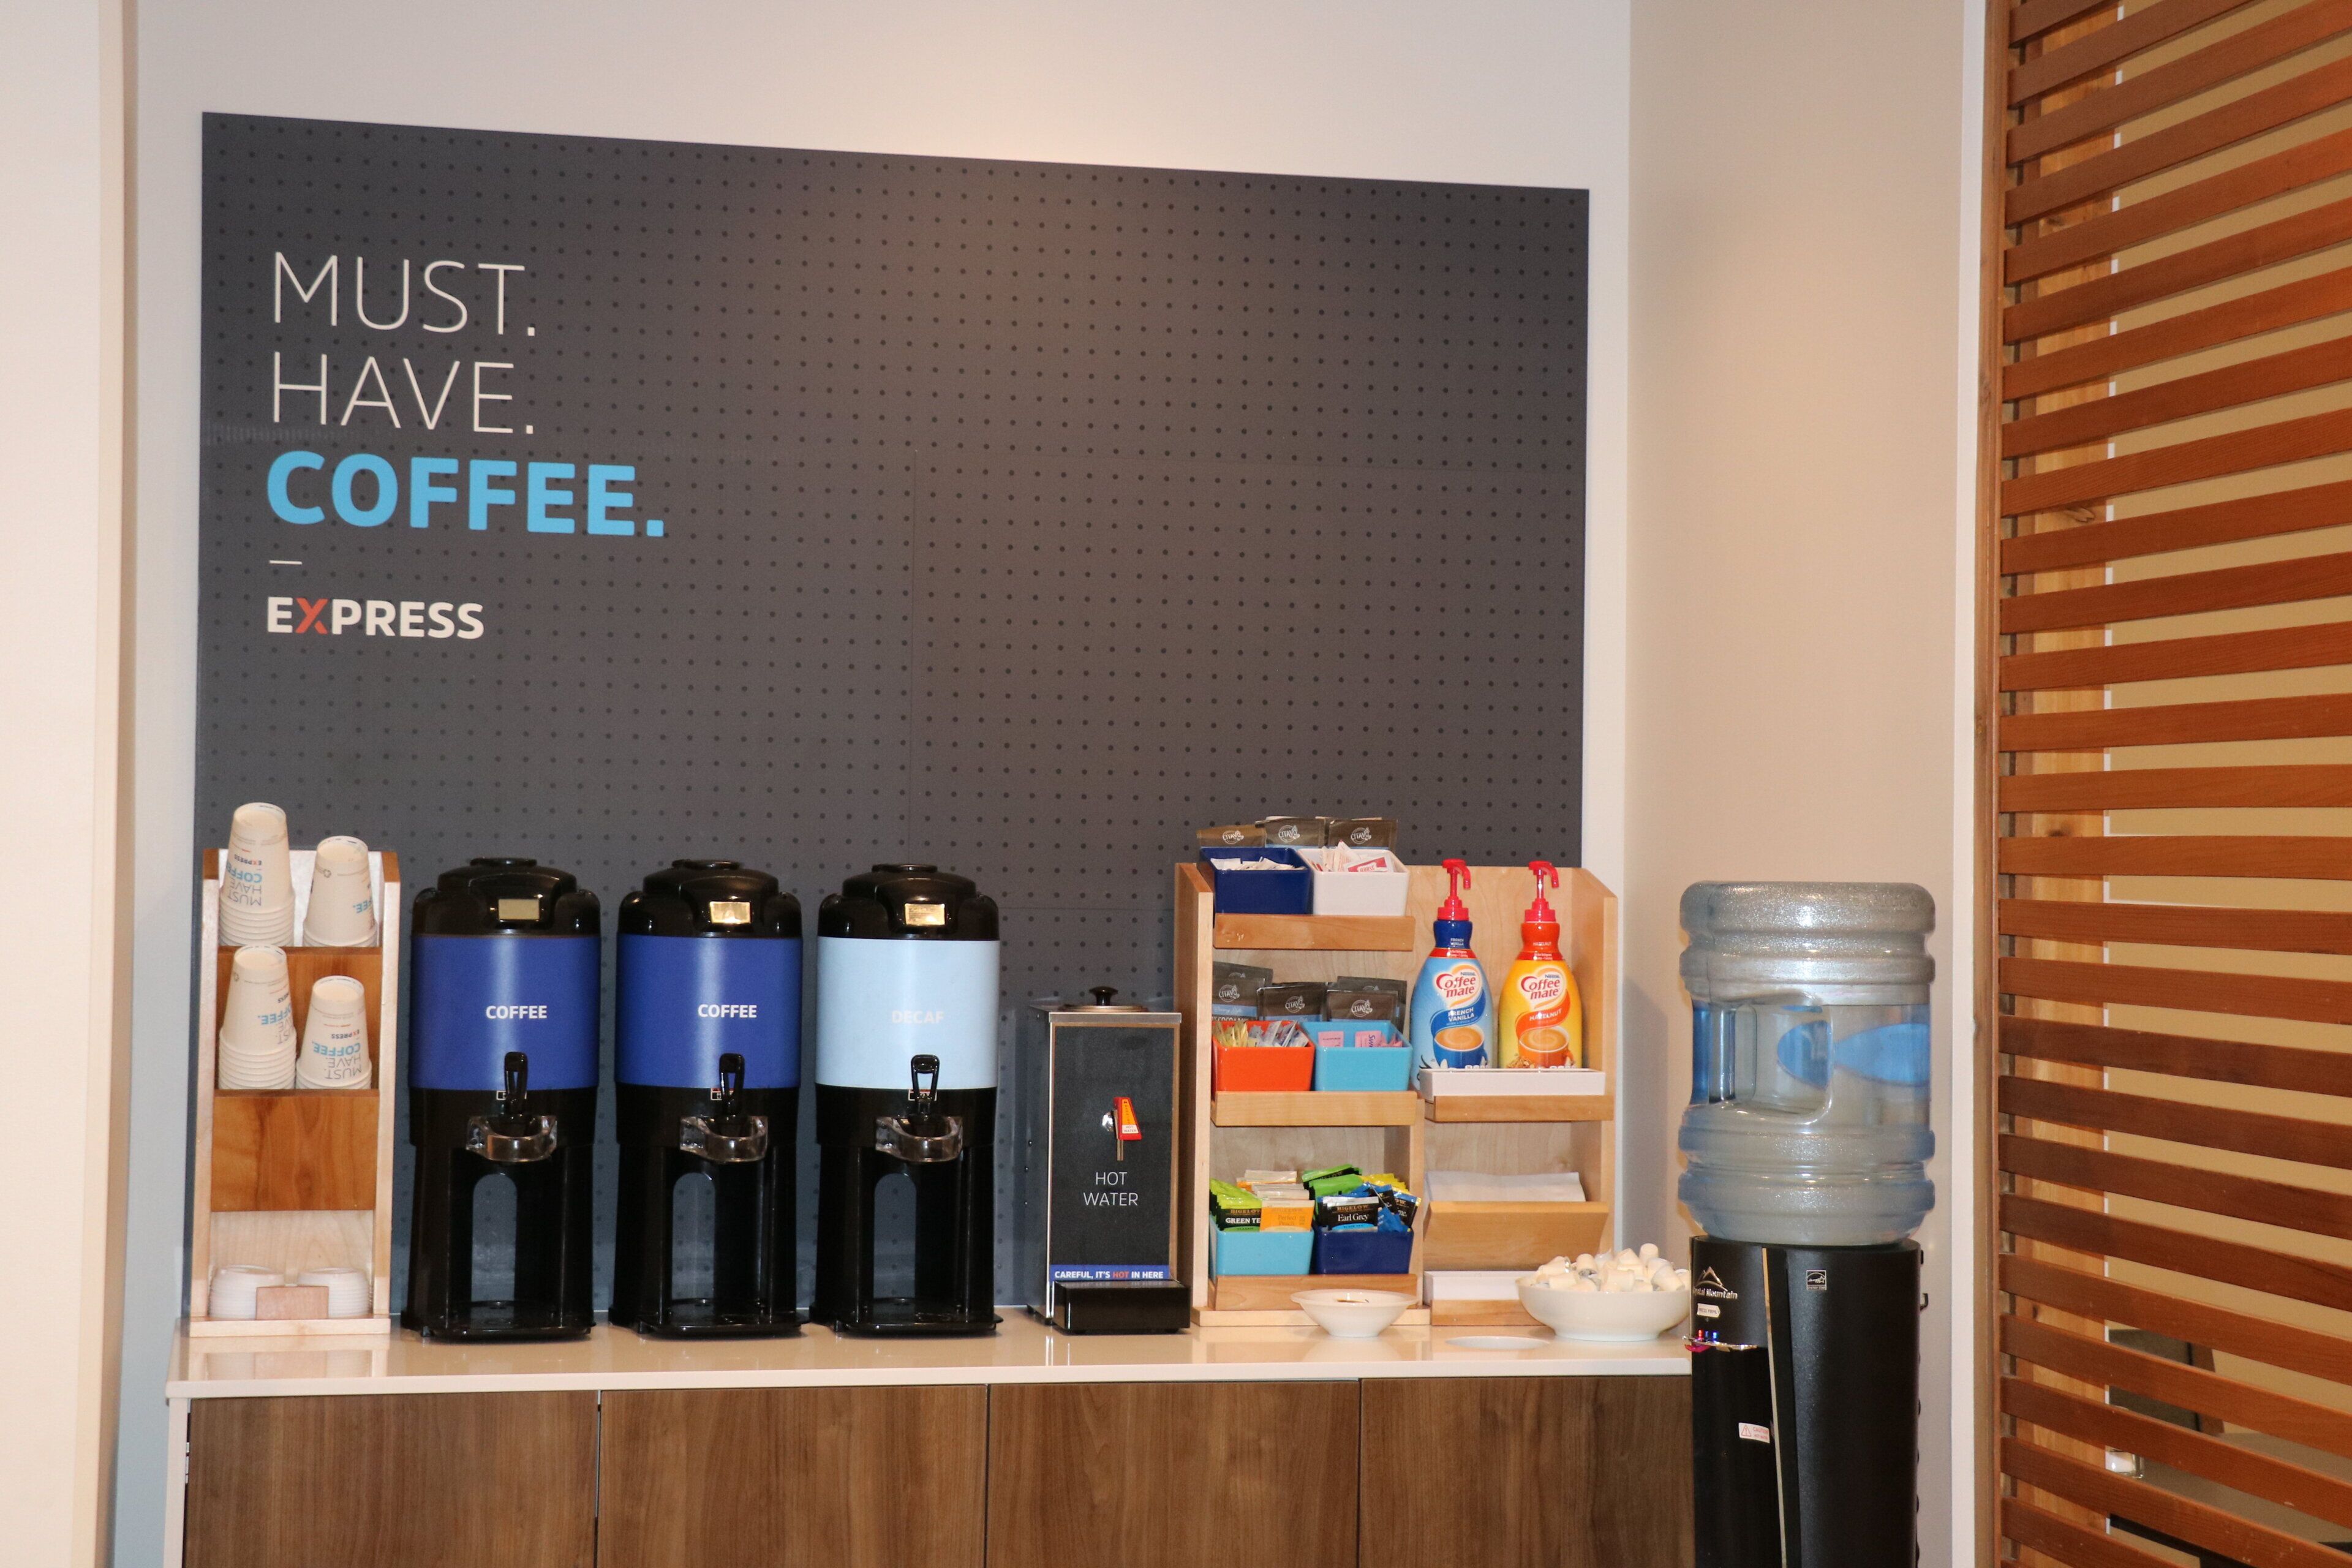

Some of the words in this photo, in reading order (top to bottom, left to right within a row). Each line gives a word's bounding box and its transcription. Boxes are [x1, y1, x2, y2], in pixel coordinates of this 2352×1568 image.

[273, 251, 535, 337] MUST.
[273, 351, 534, 435] HAVE.
[266, 450, 664, 538] COFFEE.
[267, 596, 484, 640] EXPRESS
[226, 861, 262, 883] COFFE
[1436, 973, 1476, 990] Coffee
[1521, 976, 1560, 992] Coffee
[1446, 986, 1474, 998] mate
[1530, 989, 1559, 1000] mate
[486, 1005, 547, 1019] COFFEE
[698, 1004, 757, 1018] COFFEE
[892, 1010, 944, 1024] DECAF
[1448, 1007, 1474, 1017] FRENCH
[1448, 1012, 1474, 1022] VANILLA
[331, 1029, 360, 1039] EXPRESS
[312, 1040, 361, 1057] COFFEE.
[325, 1053, 361, 1068] HAVE.
[324, 1065, 362, 1080] MUST.
[1096, 1172, 1127, 1185] HOT
[1083, 1192, 1139, 1206] WATER
[1338, 1213, 1352, 1222] Earl
[1706, 1288, 1738, 1299] Mountain
